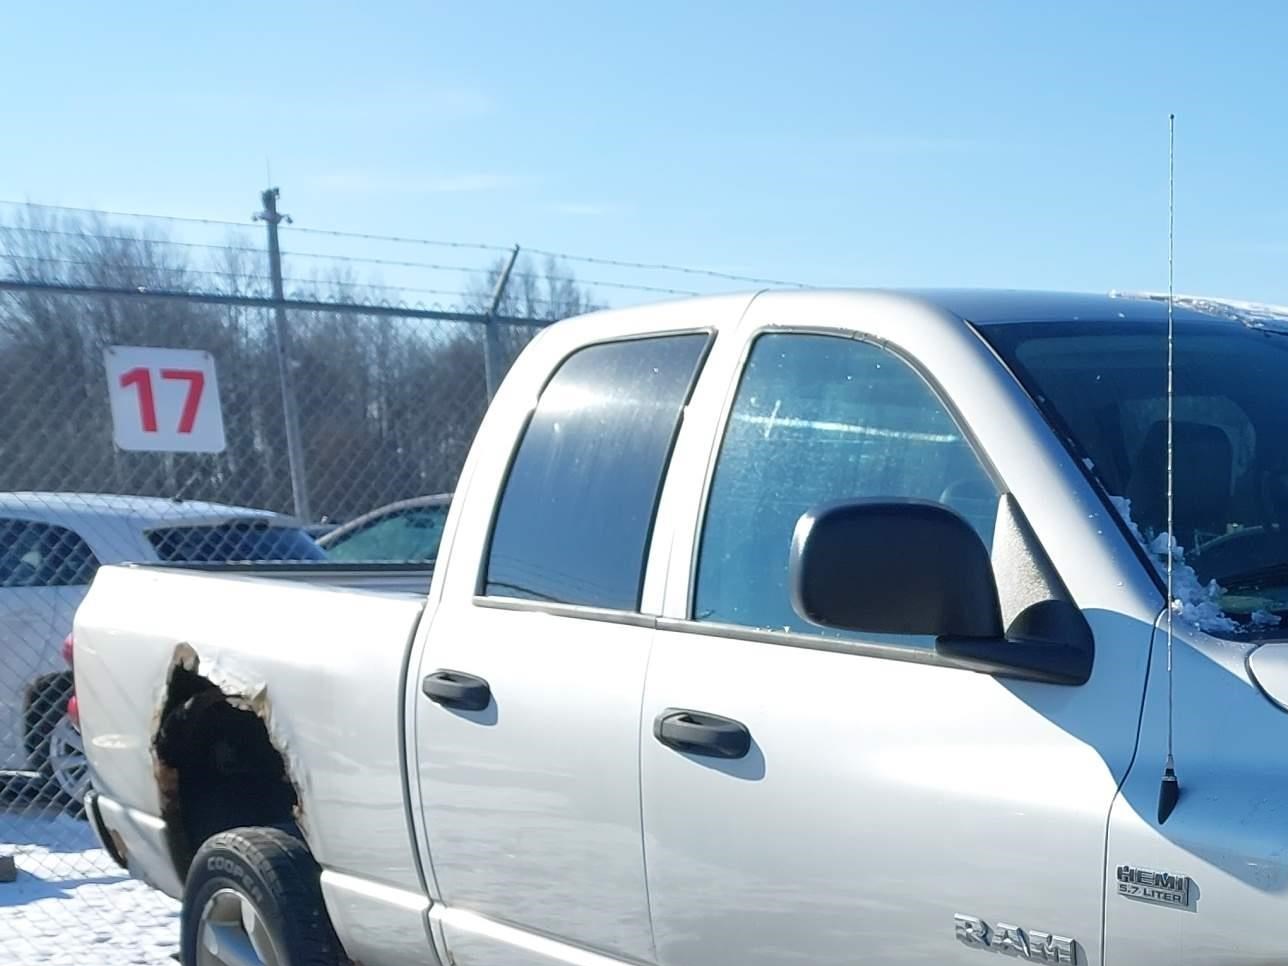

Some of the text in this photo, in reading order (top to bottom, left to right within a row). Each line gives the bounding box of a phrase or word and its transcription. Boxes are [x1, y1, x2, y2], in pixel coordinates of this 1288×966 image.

[119, 367, 205, 434] 17
[1116, 865, 1183, 891] HEMI
[1119, 884, 1182, 902] 5.7 LITER
